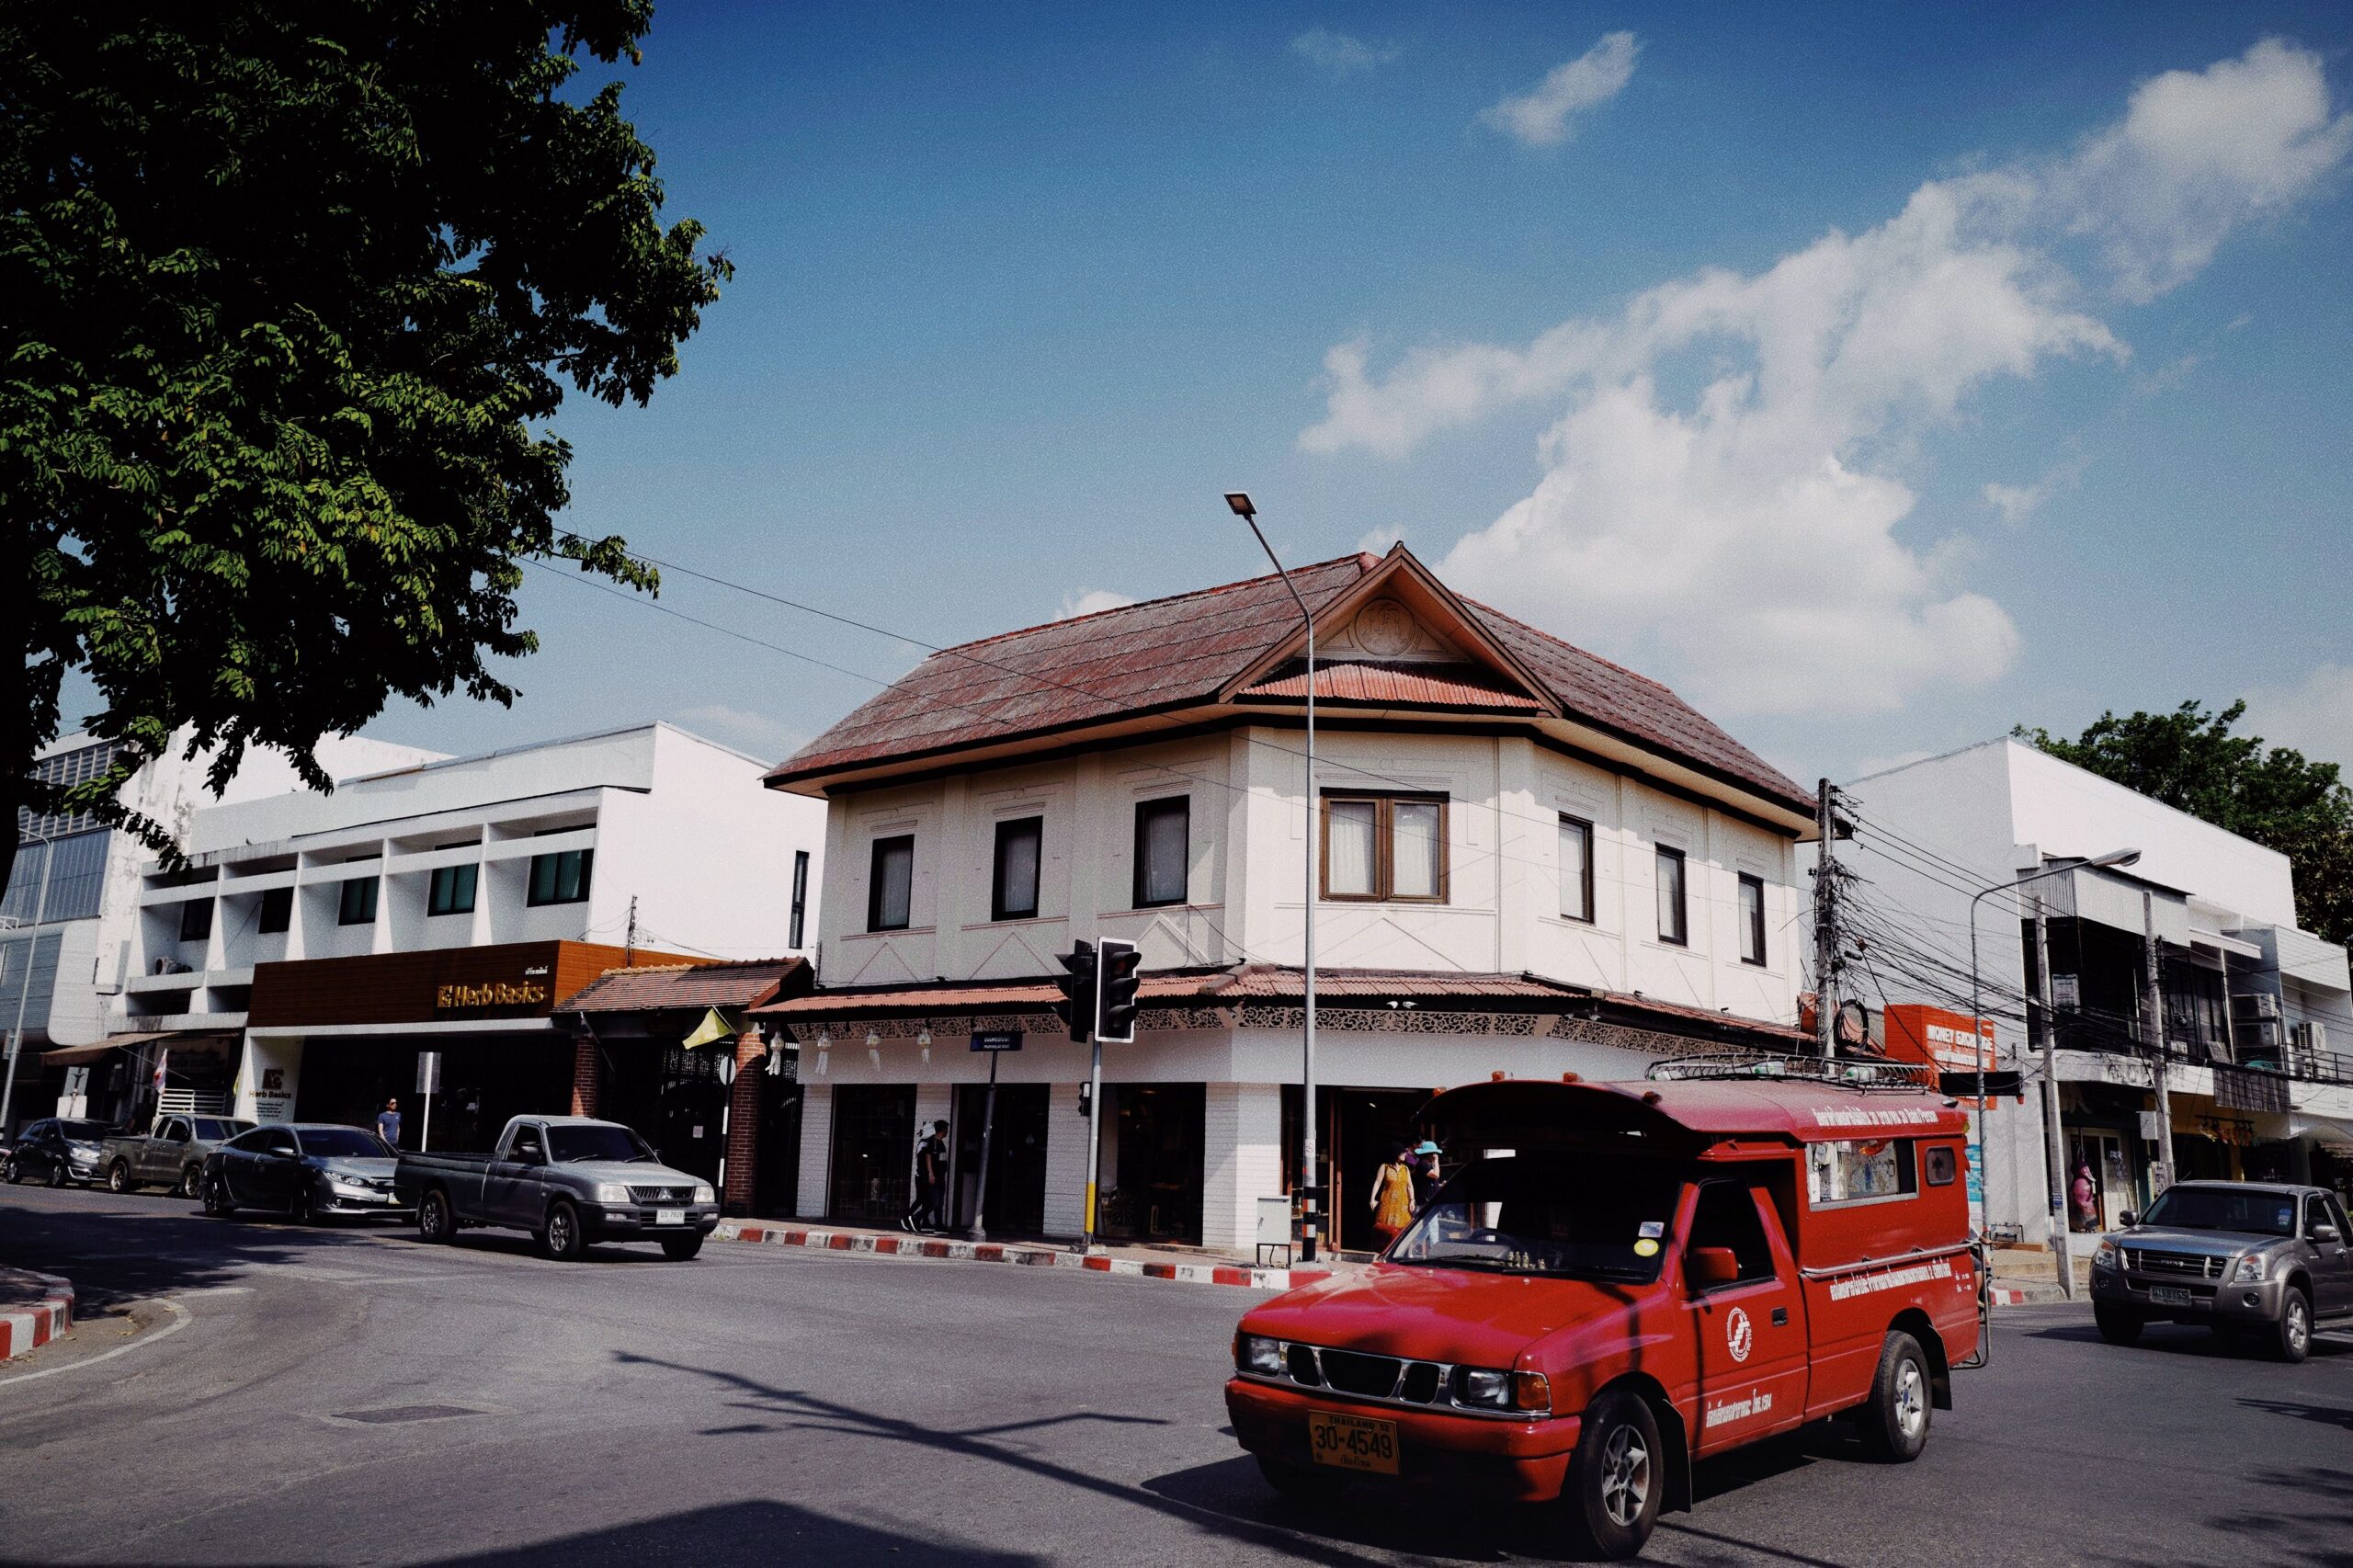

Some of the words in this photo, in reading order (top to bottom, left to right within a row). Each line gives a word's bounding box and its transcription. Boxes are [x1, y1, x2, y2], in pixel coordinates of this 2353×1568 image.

[454, 983, 493, 1007] Herb
[494, 981, 545, 1005] Basics
[1927, 1024, 1954, 1045] MONEY
[249, 1090, 267, 1099] Herb
[268, 1091, 291, 1099] Basics
[1329, 1416, 1375, 1428] THAILAND
[1315, 1424, 1392, 1460] 30-4549
